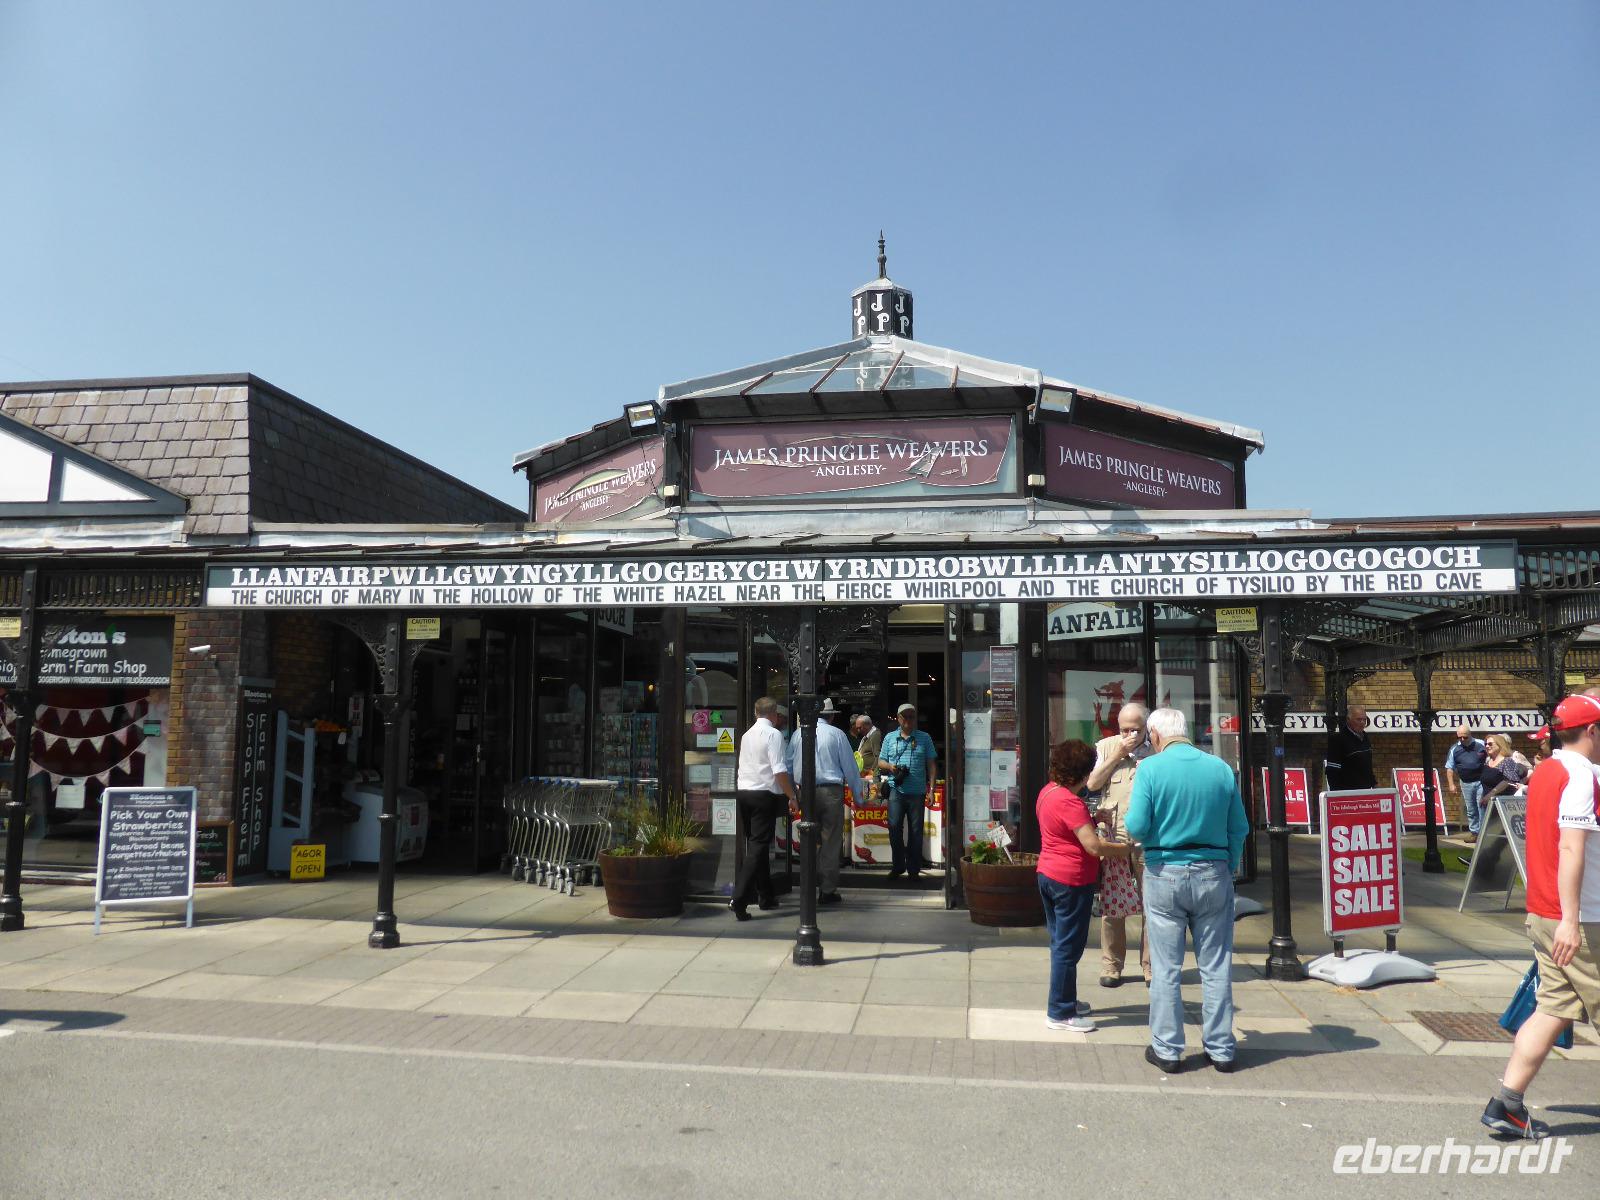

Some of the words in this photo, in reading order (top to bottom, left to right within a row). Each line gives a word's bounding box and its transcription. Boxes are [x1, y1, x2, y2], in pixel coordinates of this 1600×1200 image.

[714, 446, 780, 471] JAMES
[785, 443, 880, 464] PRINGLE
[886, 439, 989, 460] WEAVERS
[1058, 445, 1103, 470] JAMES
[1106, 456, 1164, 484] PRINGLE
[1166, 469, 1222, 496] WEAVERS
[232, 589, 257, 605] THE
[265, 589, 323, 605] CHURCH
[331, 589, 350, 604] OF
[358, 588, 401, 604] MARY
[409, 588, 424, 604] IN
[433, 588, 461, 604] THE
[471, 587, 534, 604] HOLLOW
[544, 587, 564, 603] OF
[573, 586, 602, 603] THE
[613, 585, 664, 602] WHITE
[674, 585, 726, 602] HAZEL
[736, 584, 781, 601] NEAR
[792, 583, 823, 600] THE
[836, 581, 892, 599] FIERCE
[904, 580, 1006, 598] WHIRLPOOL
[1018, 579, 1055, 597] AND
[1068, 579, 1100, 596] THE
[1110, 578, 1184, 596] CHURCH
[1196, 576, 1219, 594] OF
[1226, 575, 1295, 594] TYSILIO
[1306, 574, 1329, 592] BY
[1340, 574, 1375, 592] THE
[1387, 573, 1423, 591] RED
[1435, 572, 1482, 590] CAVE
[1221, 608, 1252, 616] CAUTION
[74, 659, 109, 675] Farm
[113, 660, 148, 677] Shop
[245, 713, 255, 778] Siop
[256, 713, 268, 772] Farm
[110, 810, 133, 820] Pick
[136, 810, 162, 820] Your
[165, 809, 189, 819] Own
[112, 820, 184, 832] Strawberries
[253, 787, 263, 850] Shop
[1331, 822, 1393, 853] SALE
[295, 864, 321, 874] OPEN
[296, 849, 322, 859] AGOR
[1332, 854, 1394, 884] SALE
[1334, 885, 1395, 916] SALE
